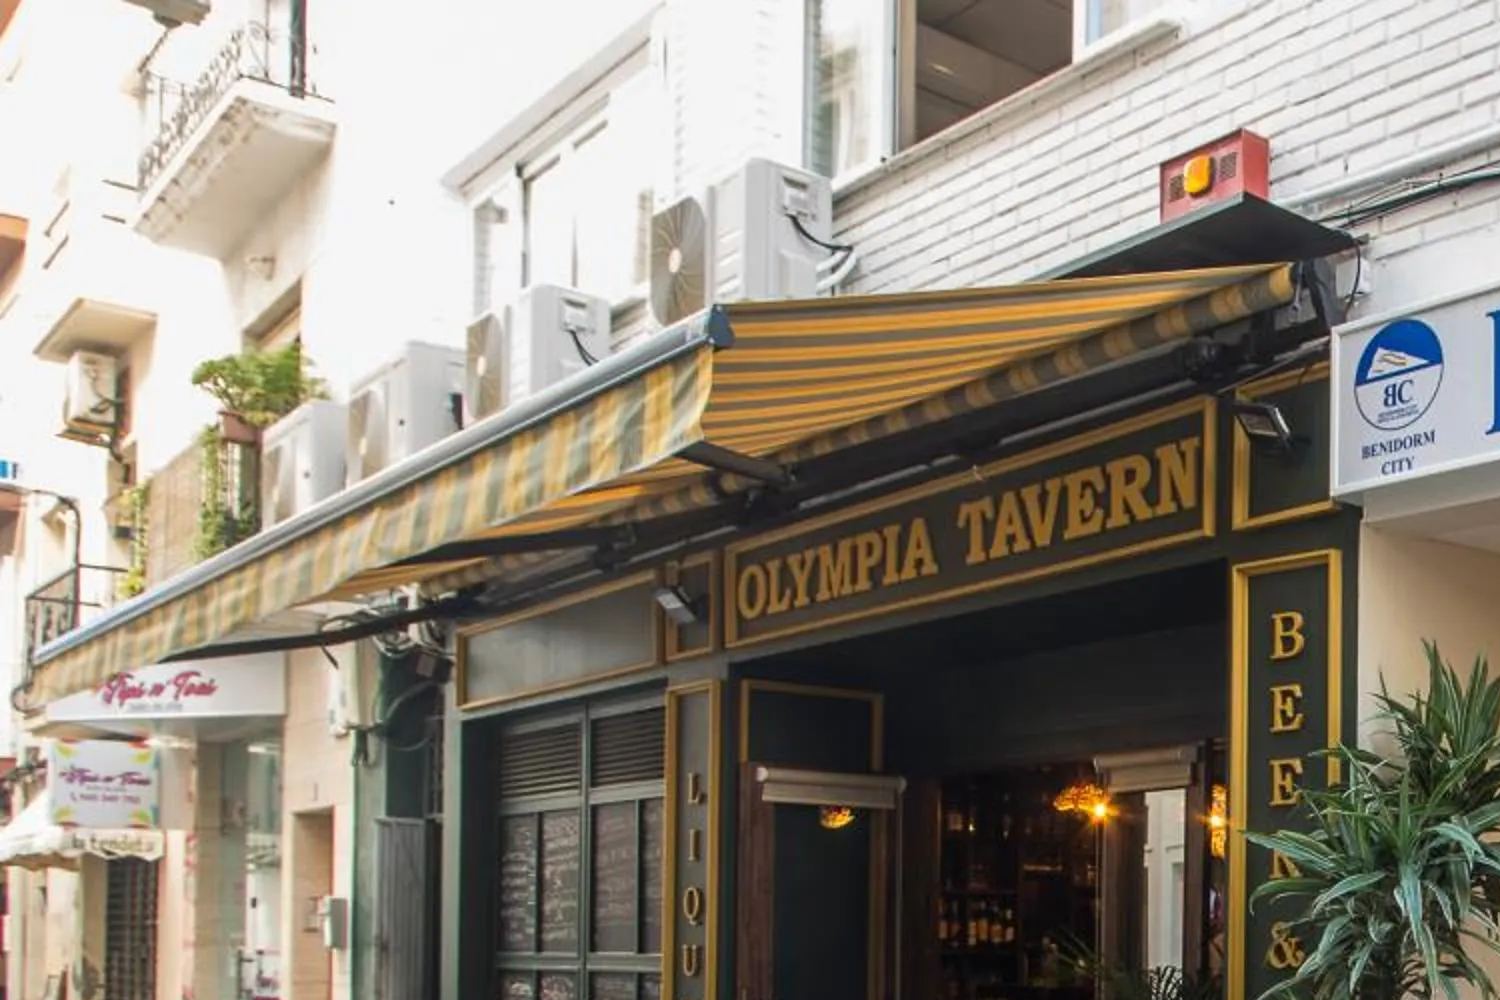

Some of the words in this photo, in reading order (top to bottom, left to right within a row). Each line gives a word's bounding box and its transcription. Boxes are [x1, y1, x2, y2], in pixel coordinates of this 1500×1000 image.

[1361, 429, 1436, 460] BENIDORM
[1381, 456, 1415, 476] CITY
[737, 517, 939, 621] OLYMPIA
[957, 436, 1201, 566] TAVERN
